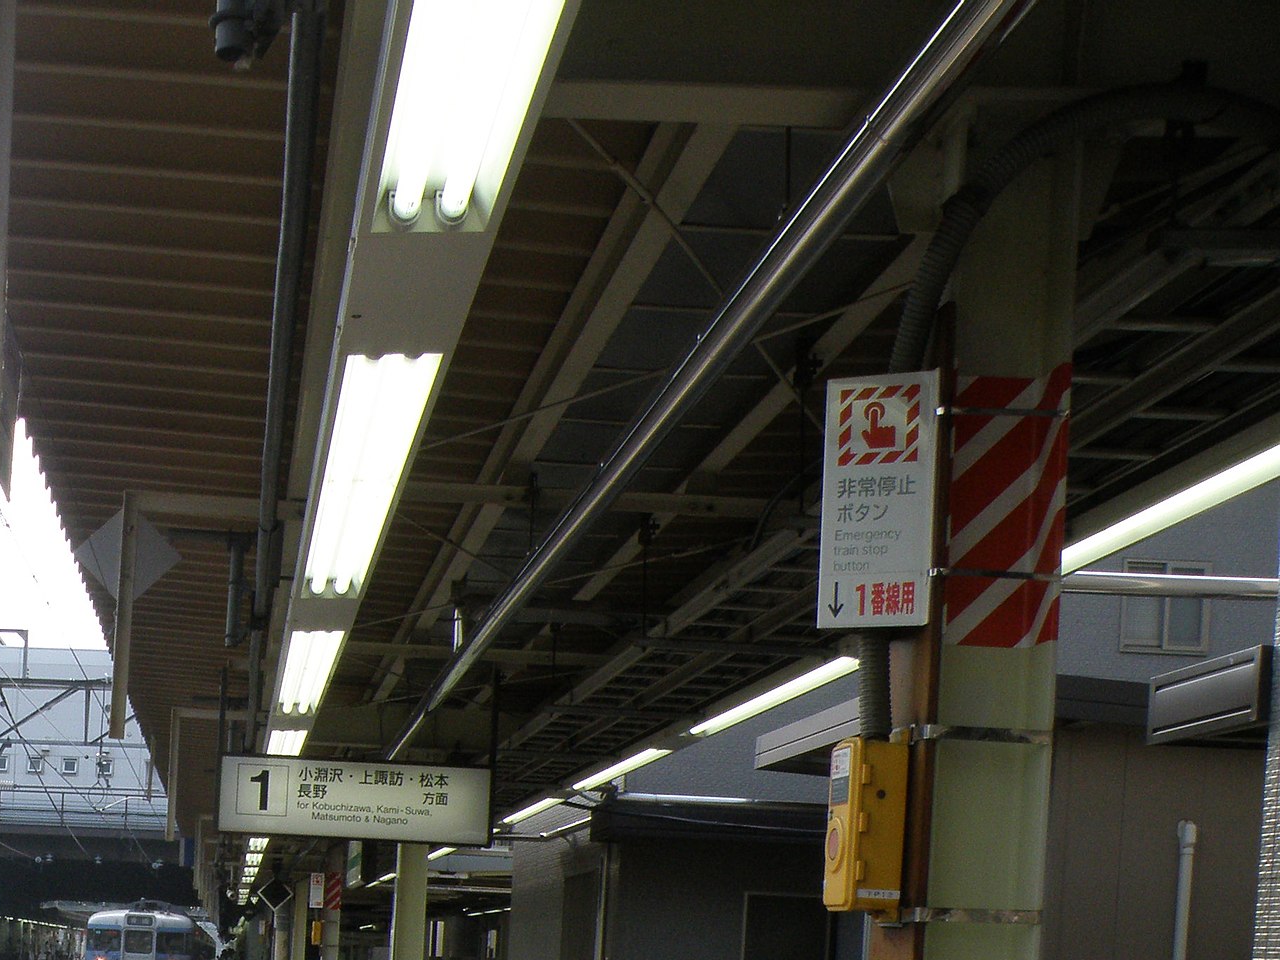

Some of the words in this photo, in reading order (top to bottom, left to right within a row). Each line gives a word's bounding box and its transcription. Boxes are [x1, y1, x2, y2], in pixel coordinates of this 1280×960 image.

[837, 475, 916, 499] 非常停止
[837, 503, 888, 524] ボタン
[835, 530, 901, 543] Emergency
[834, 544, 859, 555] train
[863, 545, 888, 558] stop
[833, 560, 870, 571] button
[855, 582, 915, 616] 1番線用
[250, 769, 270, 811] 1
[297, 783, 328, 799] 長野
[422, 791, 448, 806] 方面
[297, 801, 309, 810] for
[312, 801, 374, 814] Kobuchizawa,
[376, 805, 433, 817] Kami-Suwa,
[311, 811, 361, 823] Matsumoto
[373, 815, 408, 826] Nagano
